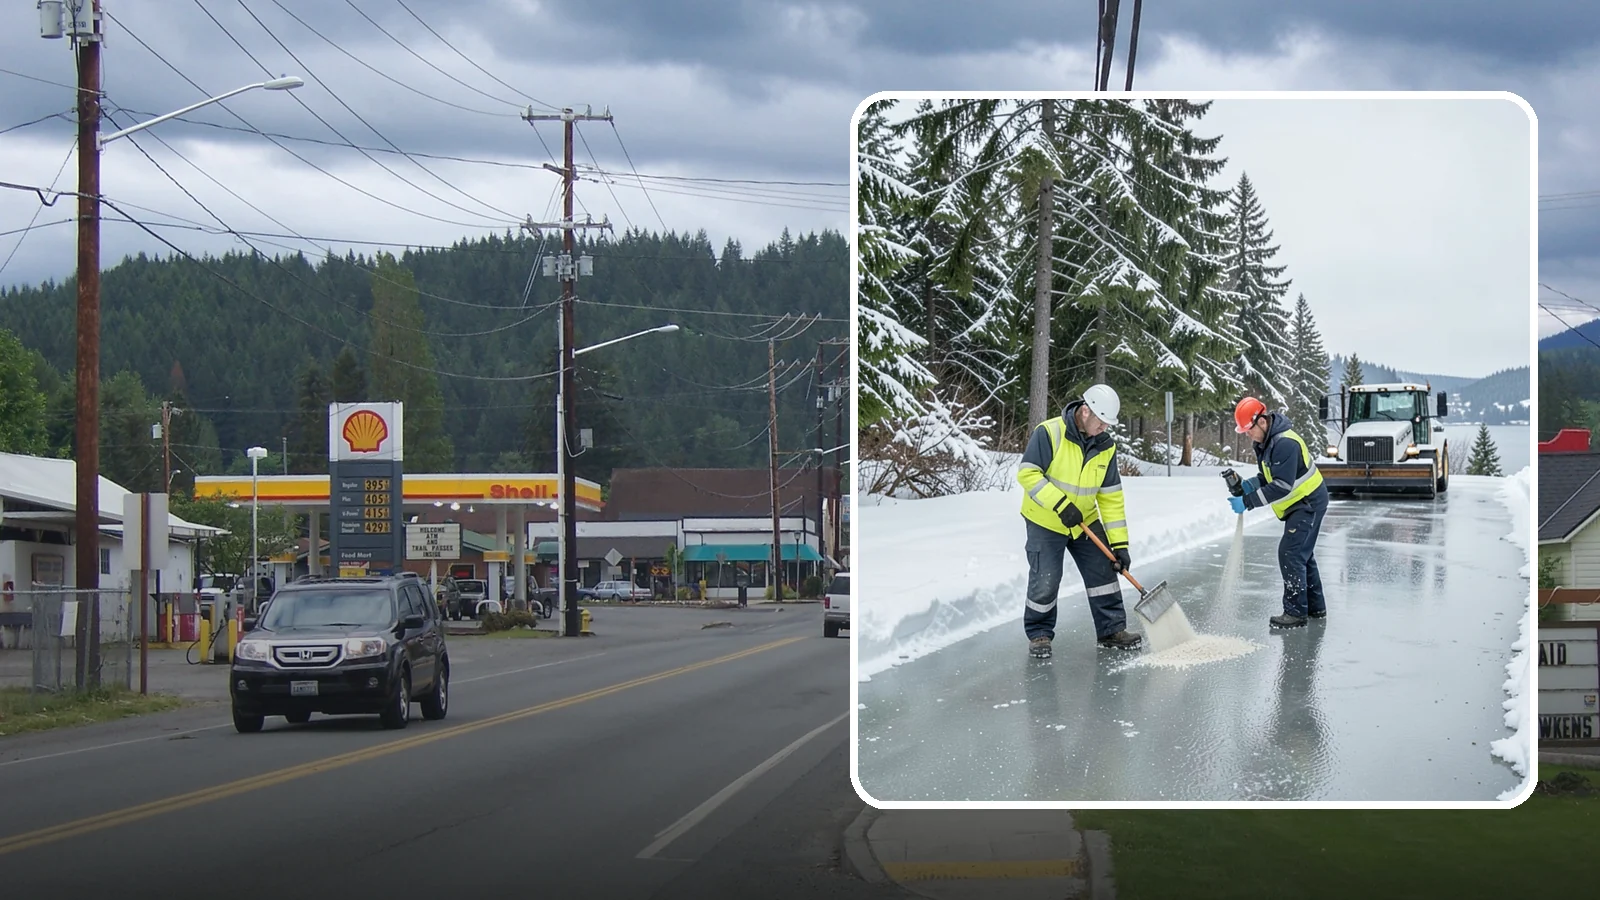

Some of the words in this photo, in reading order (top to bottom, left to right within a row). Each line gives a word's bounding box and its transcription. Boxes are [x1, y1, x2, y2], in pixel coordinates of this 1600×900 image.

[366, 480, 383, 490] 395
[490, 485, 547, 499] Shell
[366, 494, 383, 504] 405
[365, 508, 383, 518] 415
[366, 522, 383, 532] 429
